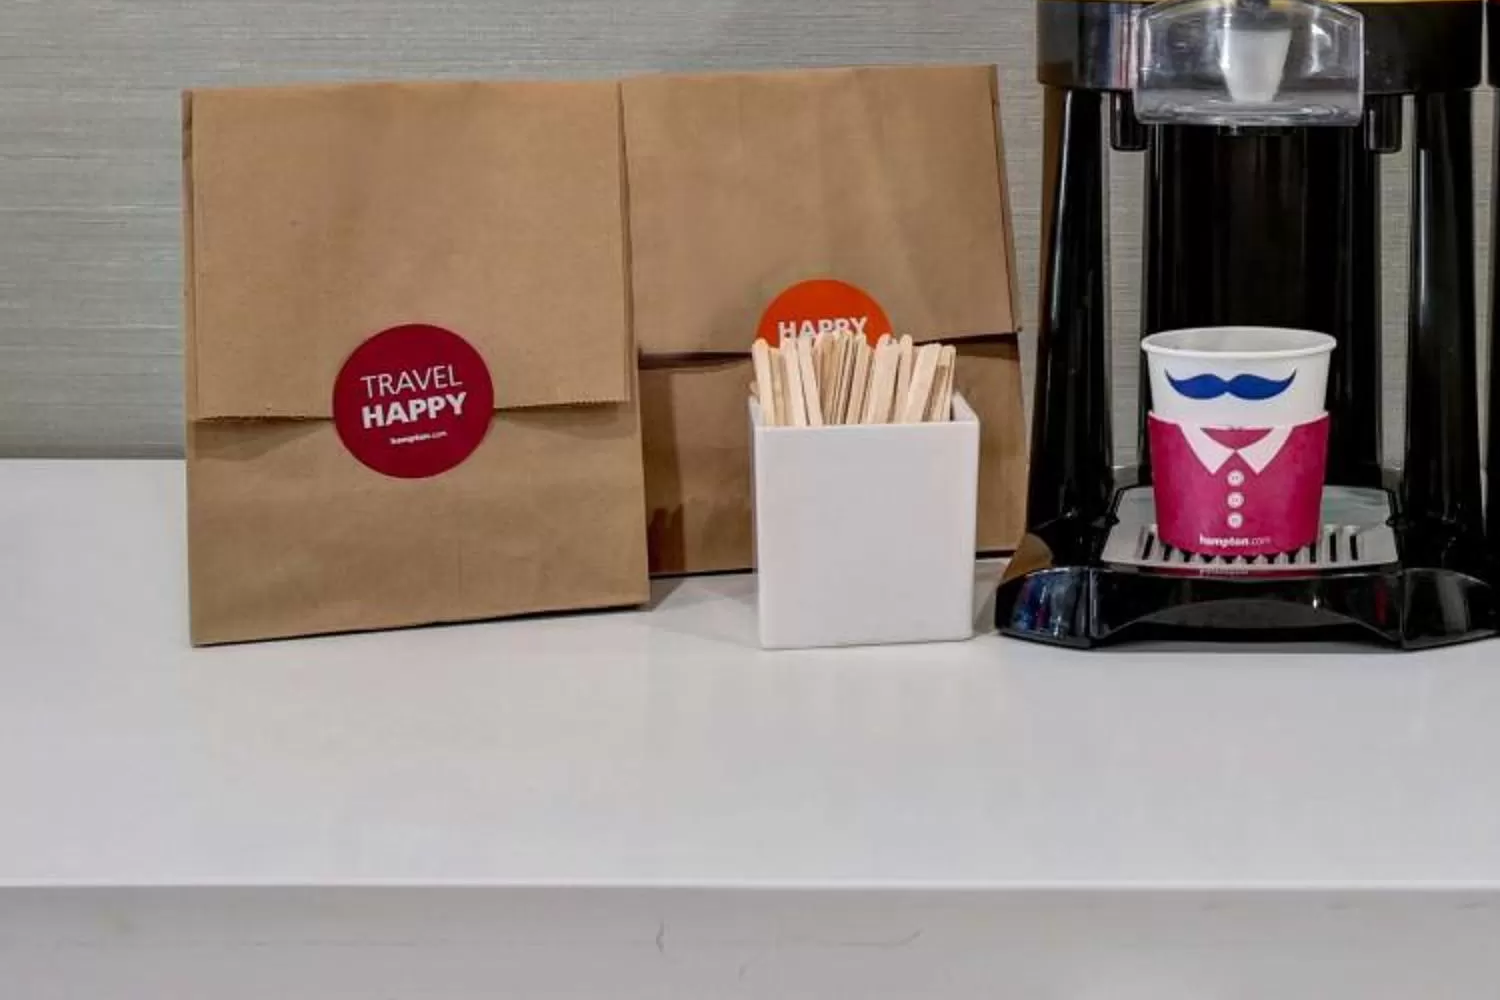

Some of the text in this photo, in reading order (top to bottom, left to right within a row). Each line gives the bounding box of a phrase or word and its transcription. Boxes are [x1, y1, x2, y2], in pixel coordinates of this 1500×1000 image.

[777, 315, 868, 341] HAPPY
[360, 363, 463, 399] TRAVEL
[361, 391, 467, 429] HAPPY
